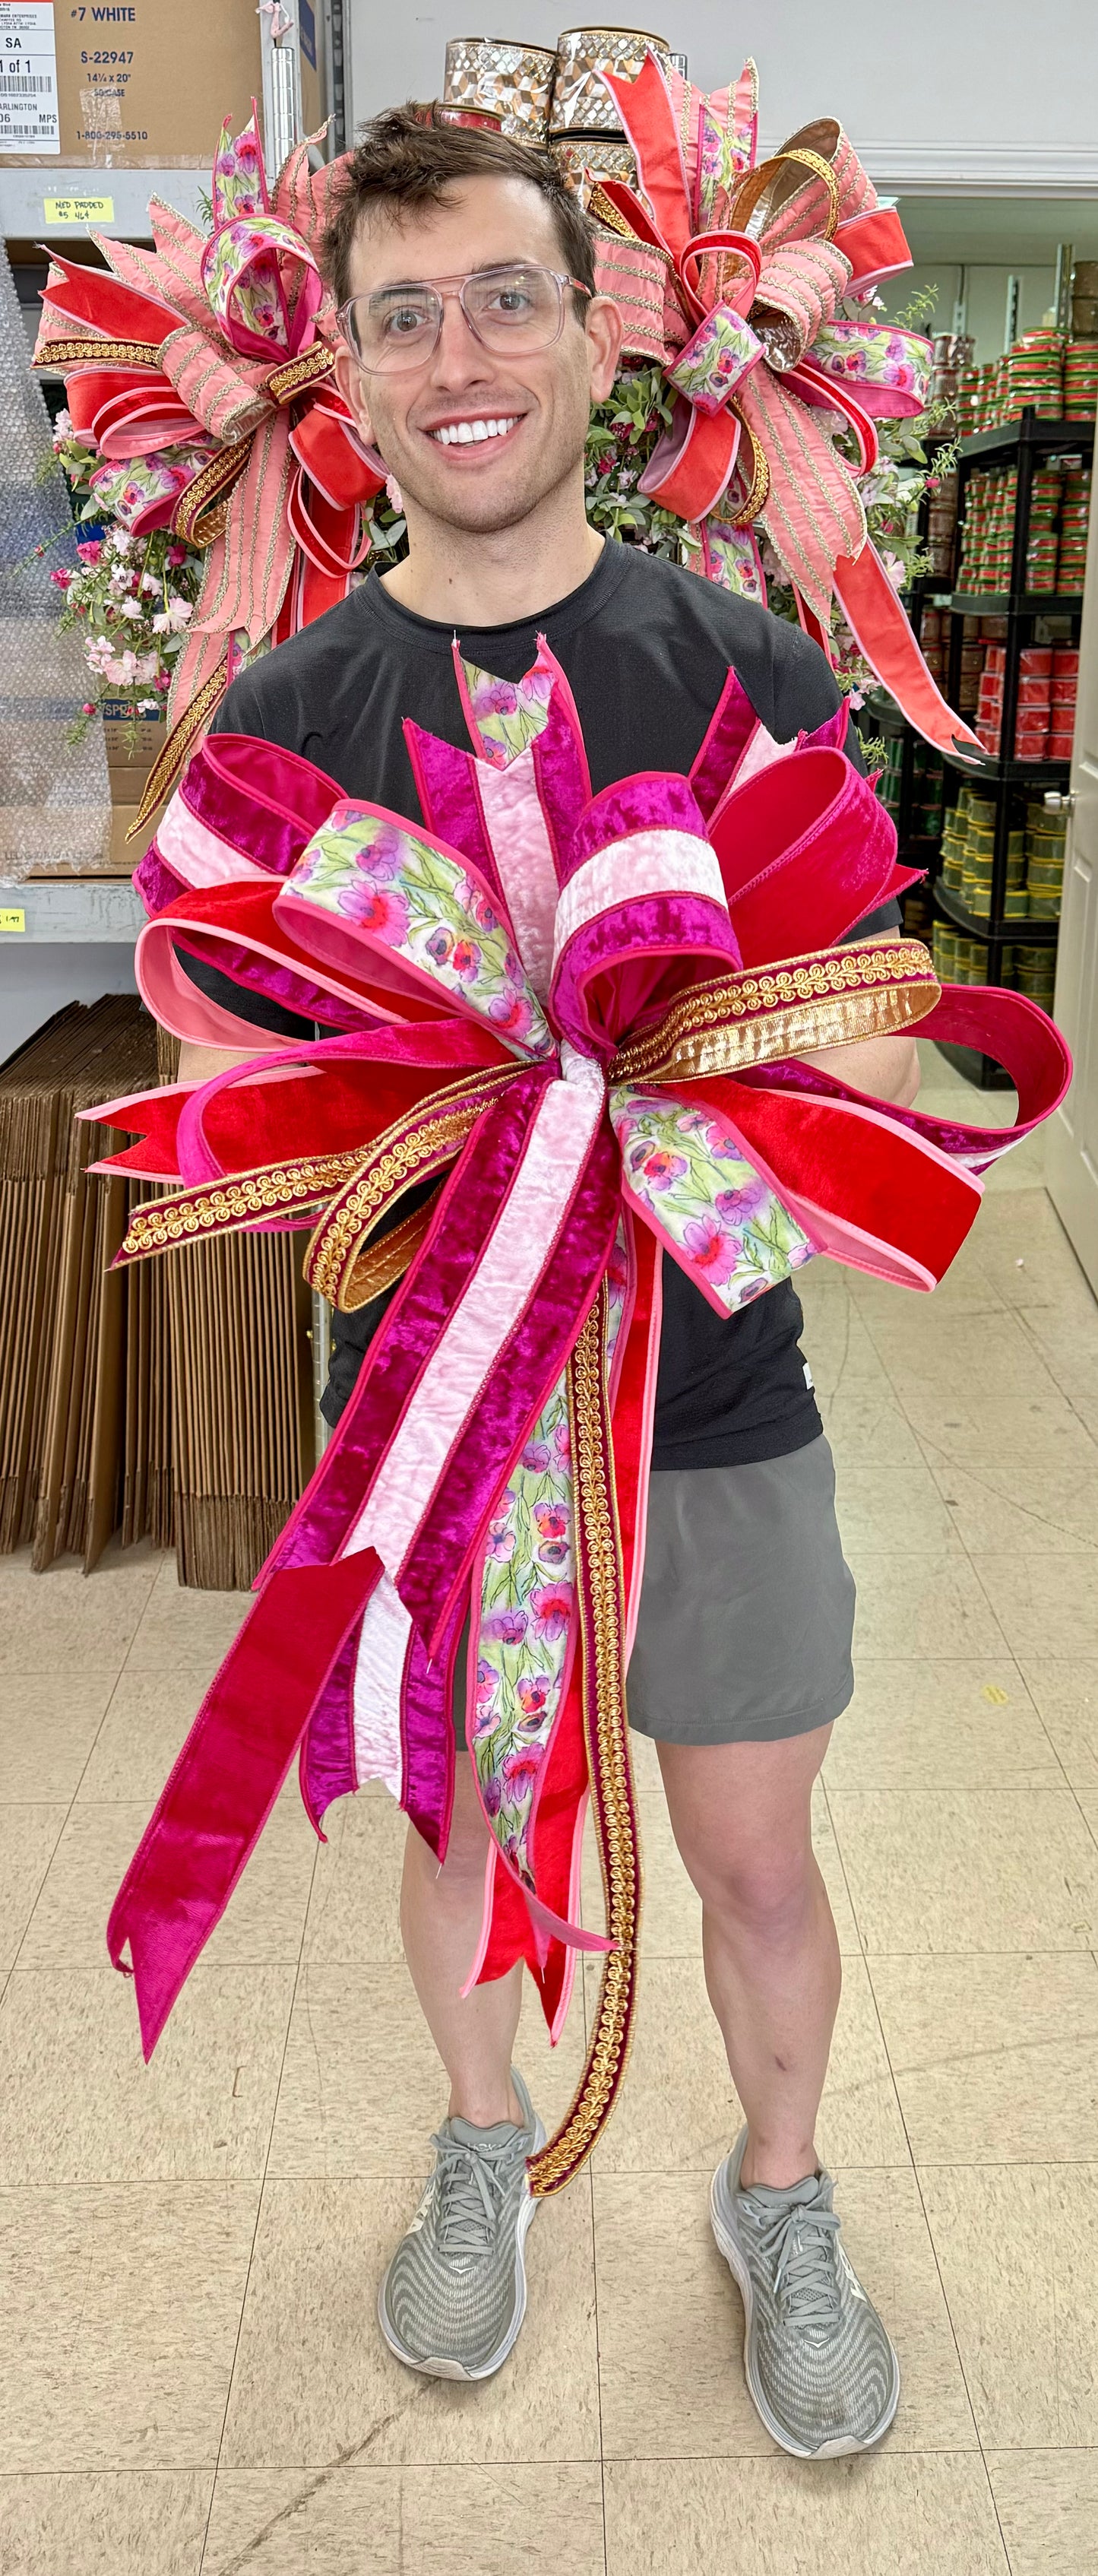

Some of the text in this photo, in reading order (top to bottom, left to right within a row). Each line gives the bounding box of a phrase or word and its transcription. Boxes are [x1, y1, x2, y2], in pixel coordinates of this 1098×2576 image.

[71, 7, 136, 21] #7 WHITE
[5, 37, 22, 48] SA
[81, 51, 134, 64] S-22947
[9, 59, 20, 73] of
[25, 59, 30, 73] 1
[0, 103, 38, 111] ARLINGTON
[39, 113, 57, 123] MPS
[77, 131, 148, 140] 1-800-295-5510
[74, 201, 103, 210] PADDED
